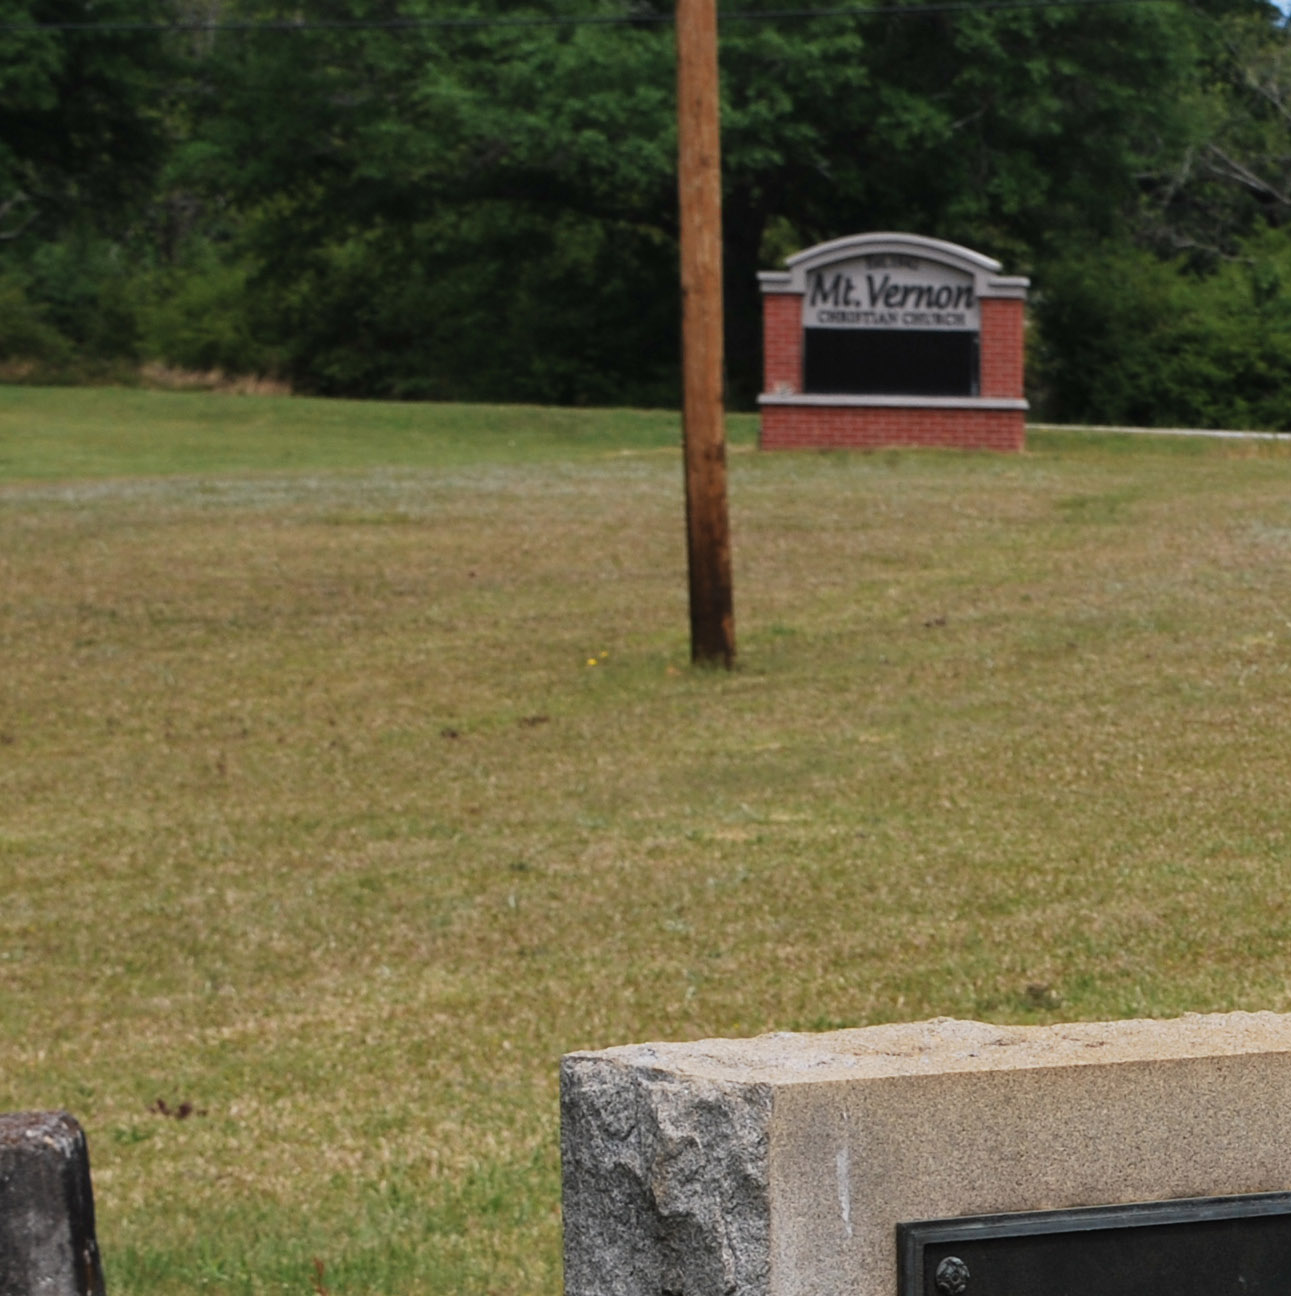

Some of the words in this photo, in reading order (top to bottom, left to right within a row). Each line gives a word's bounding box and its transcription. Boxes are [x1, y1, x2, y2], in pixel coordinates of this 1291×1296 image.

[810, 272, 861, 307] Mt.
[866, 273, 975, 309] Vernon
[902, 311, 966, 326] CHURCH
